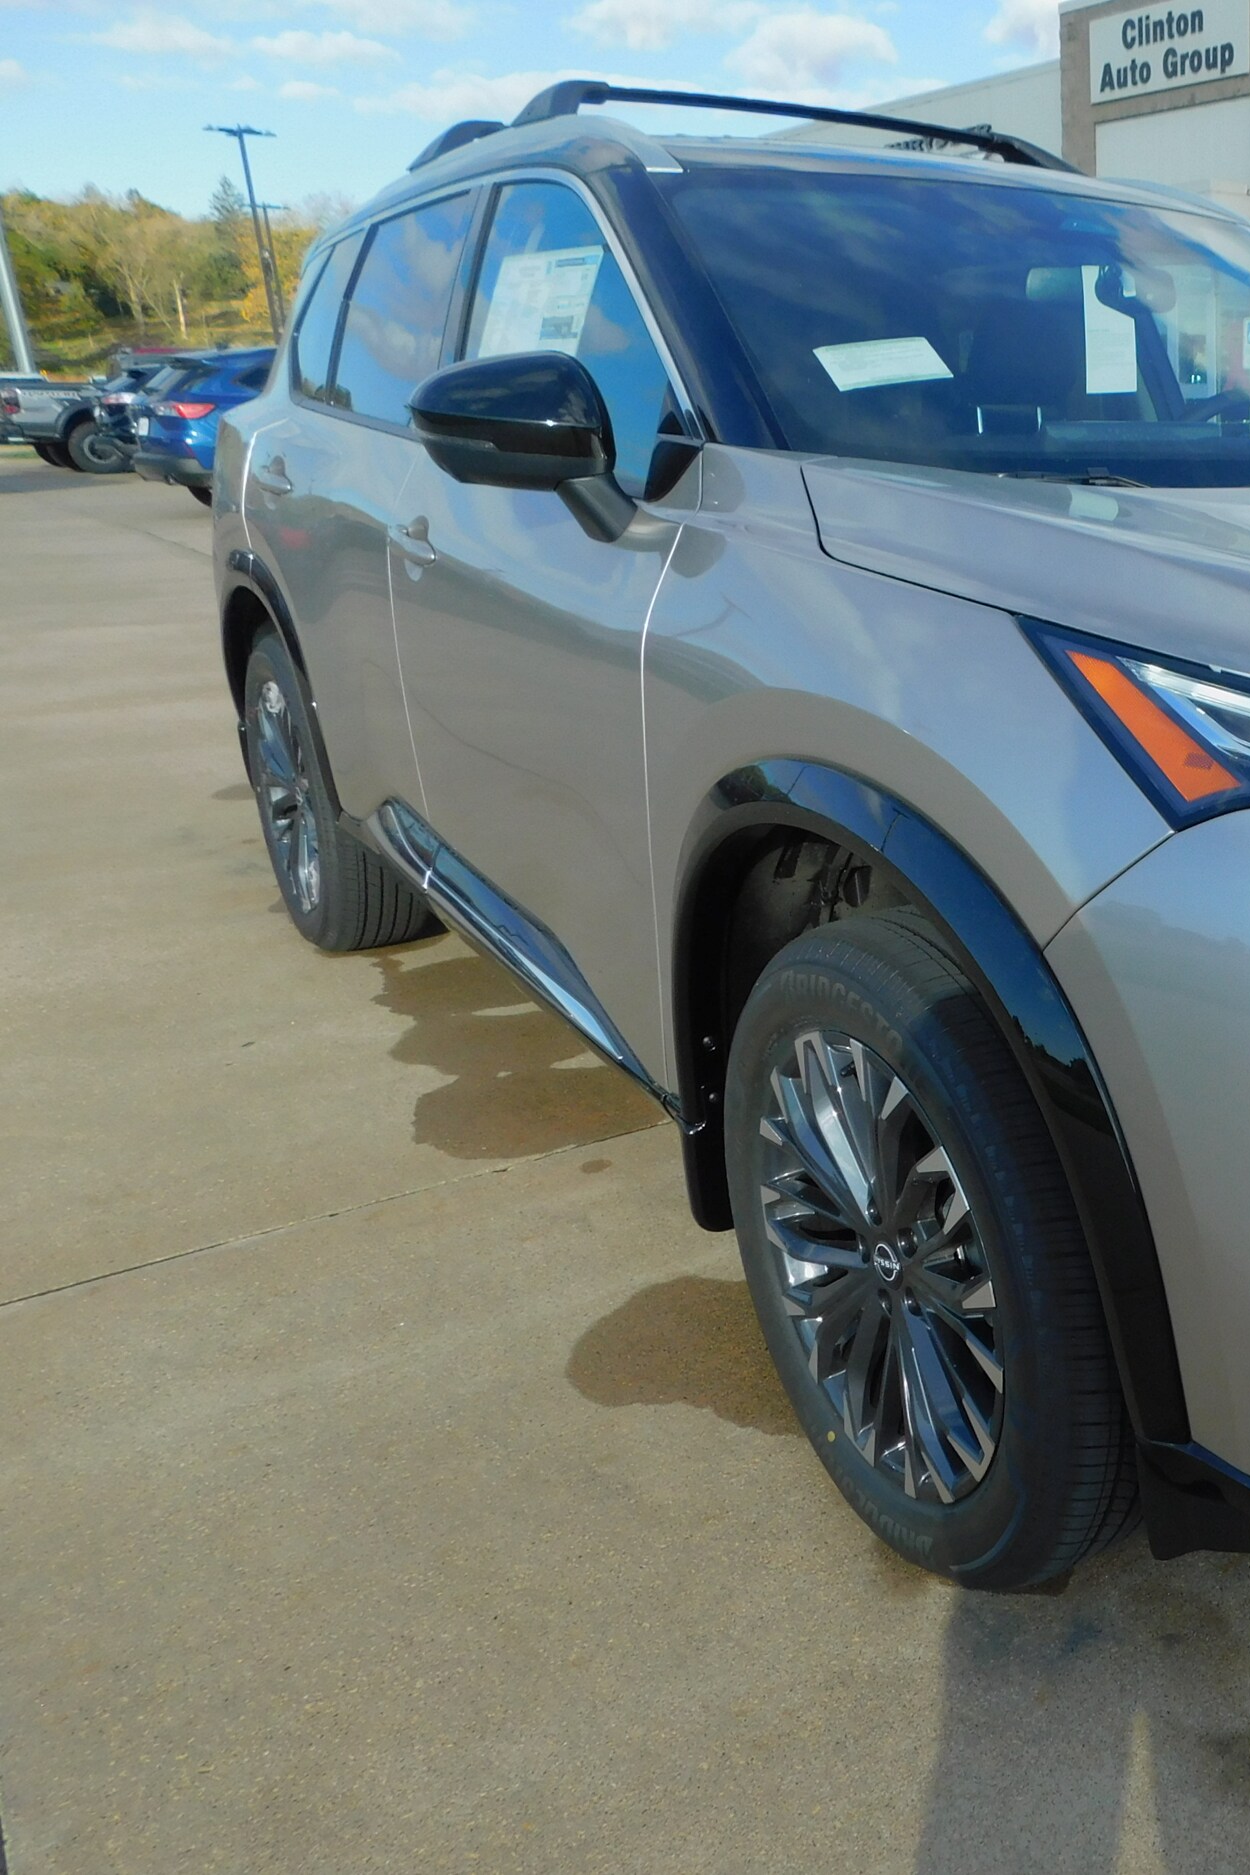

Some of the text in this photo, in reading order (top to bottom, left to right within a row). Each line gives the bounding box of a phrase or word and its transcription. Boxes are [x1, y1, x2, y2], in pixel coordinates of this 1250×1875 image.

[1121, 9, 1204, 50] Clinton
[1100, 42, 1235, 92] Auto Group
[875, 1257, 900, 1271] NISS
